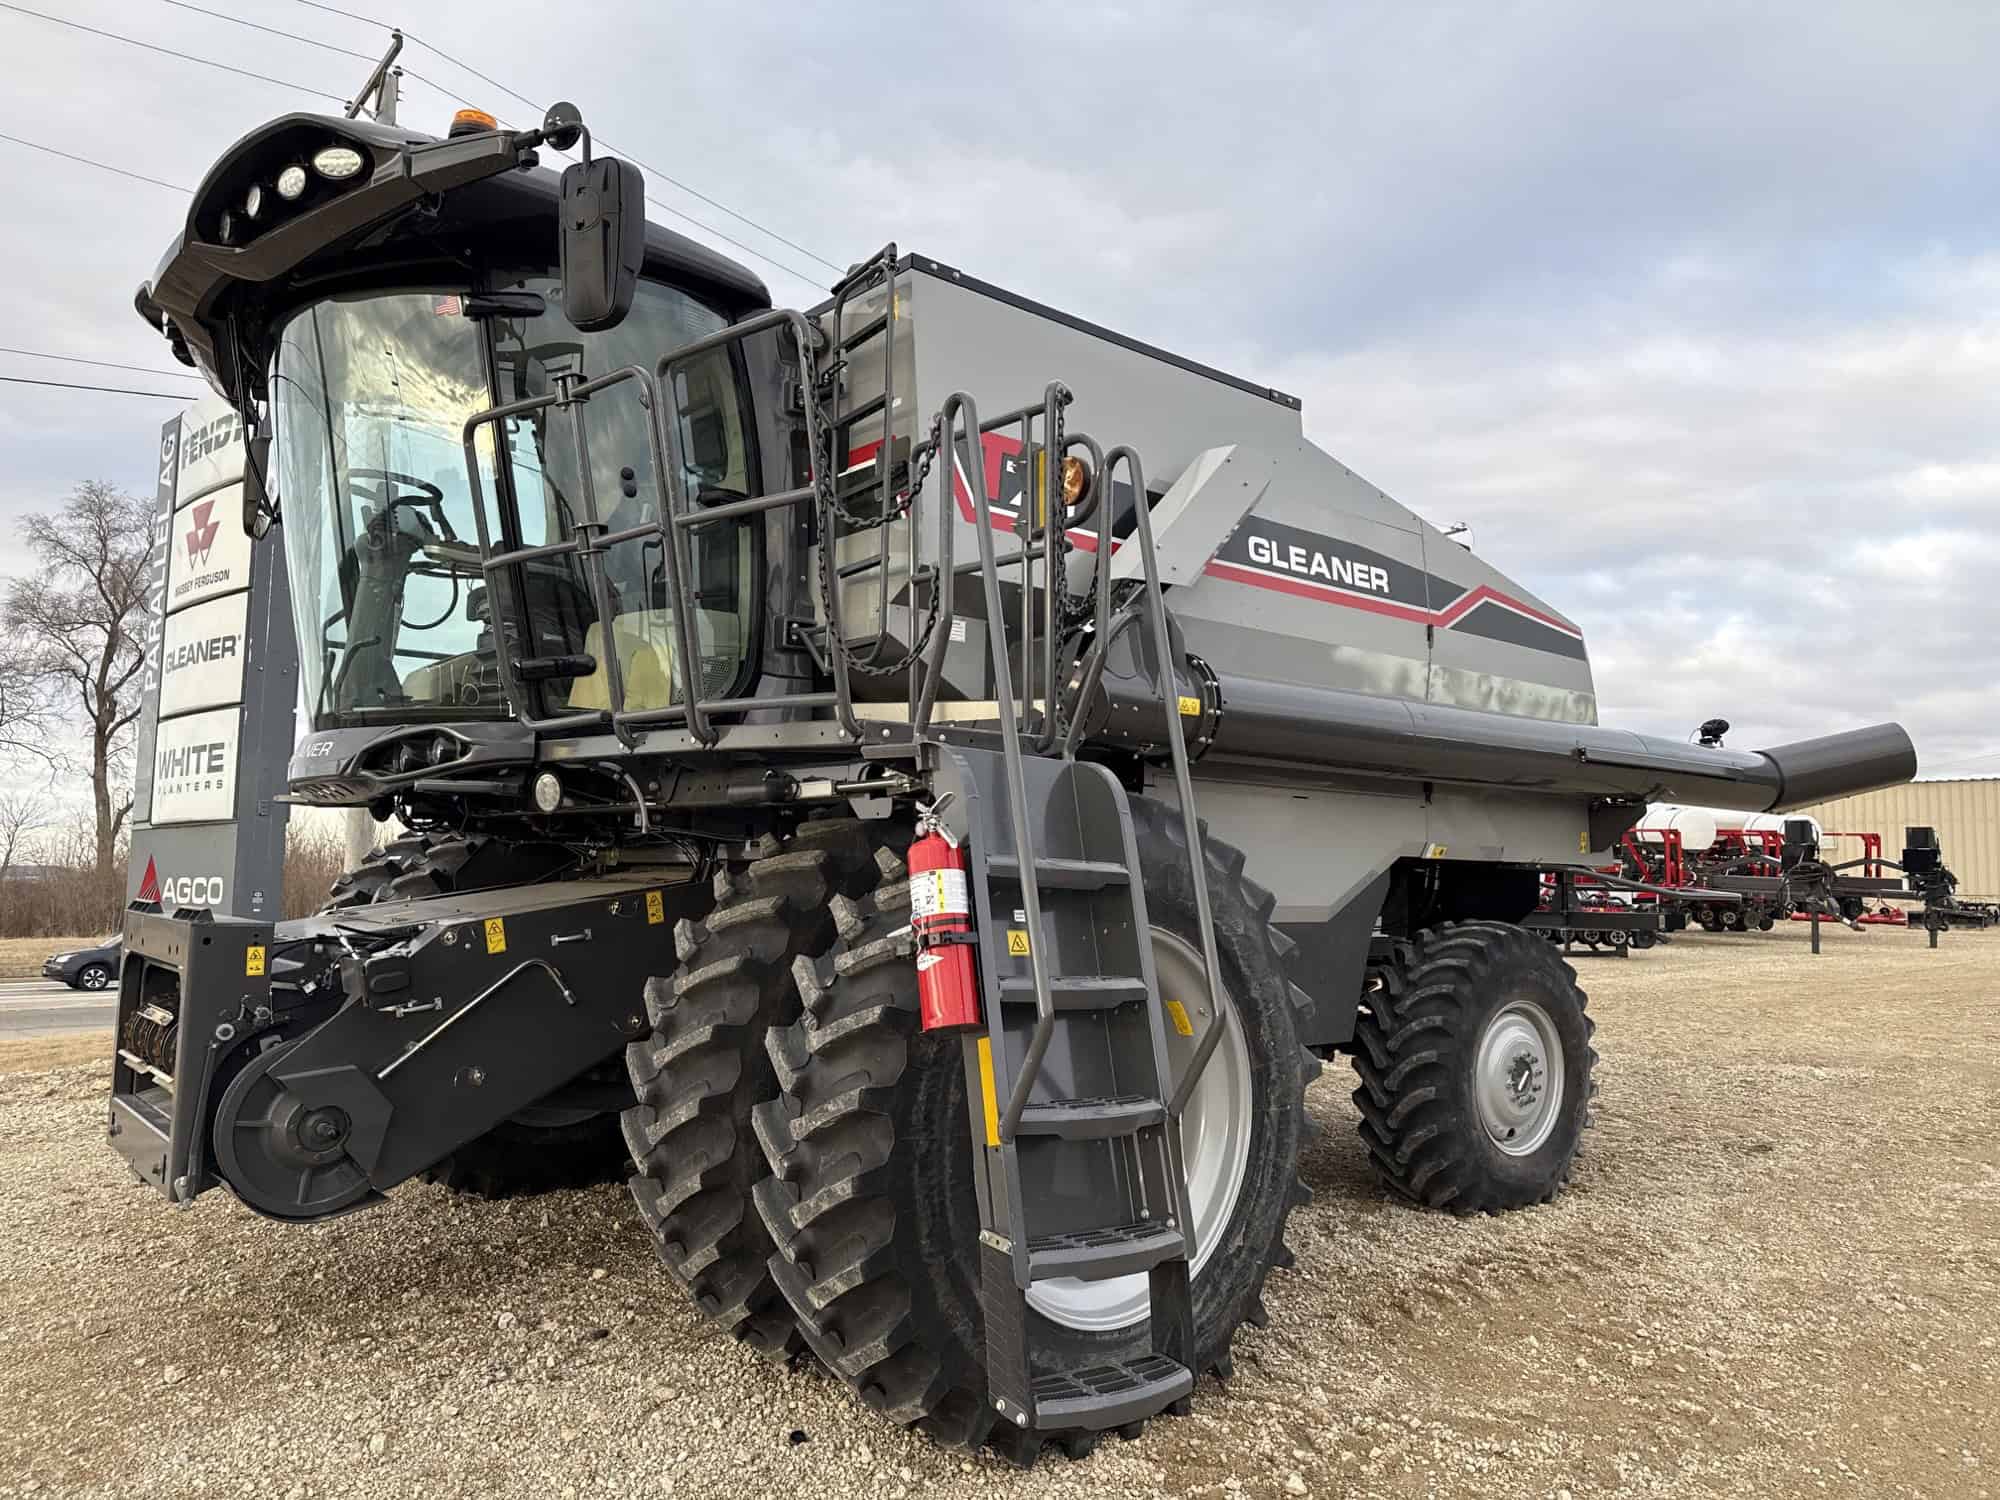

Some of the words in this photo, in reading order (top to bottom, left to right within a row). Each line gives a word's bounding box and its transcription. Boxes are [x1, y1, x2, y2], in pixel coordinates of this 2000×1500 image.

[144, 499, 175, 692] PARALLEL
[160, 432, 176, 487] AG
[194, 568, 230, 589] FERGUSON
[1247, 535, 1391, 594] GLEANER
[165, 634, 237, 674] GLEANER
[158, 742, 225, 780] WHITE
[158, 779, 224, 795] PLANTERS
[162, 876, 224, 904] AGCO
